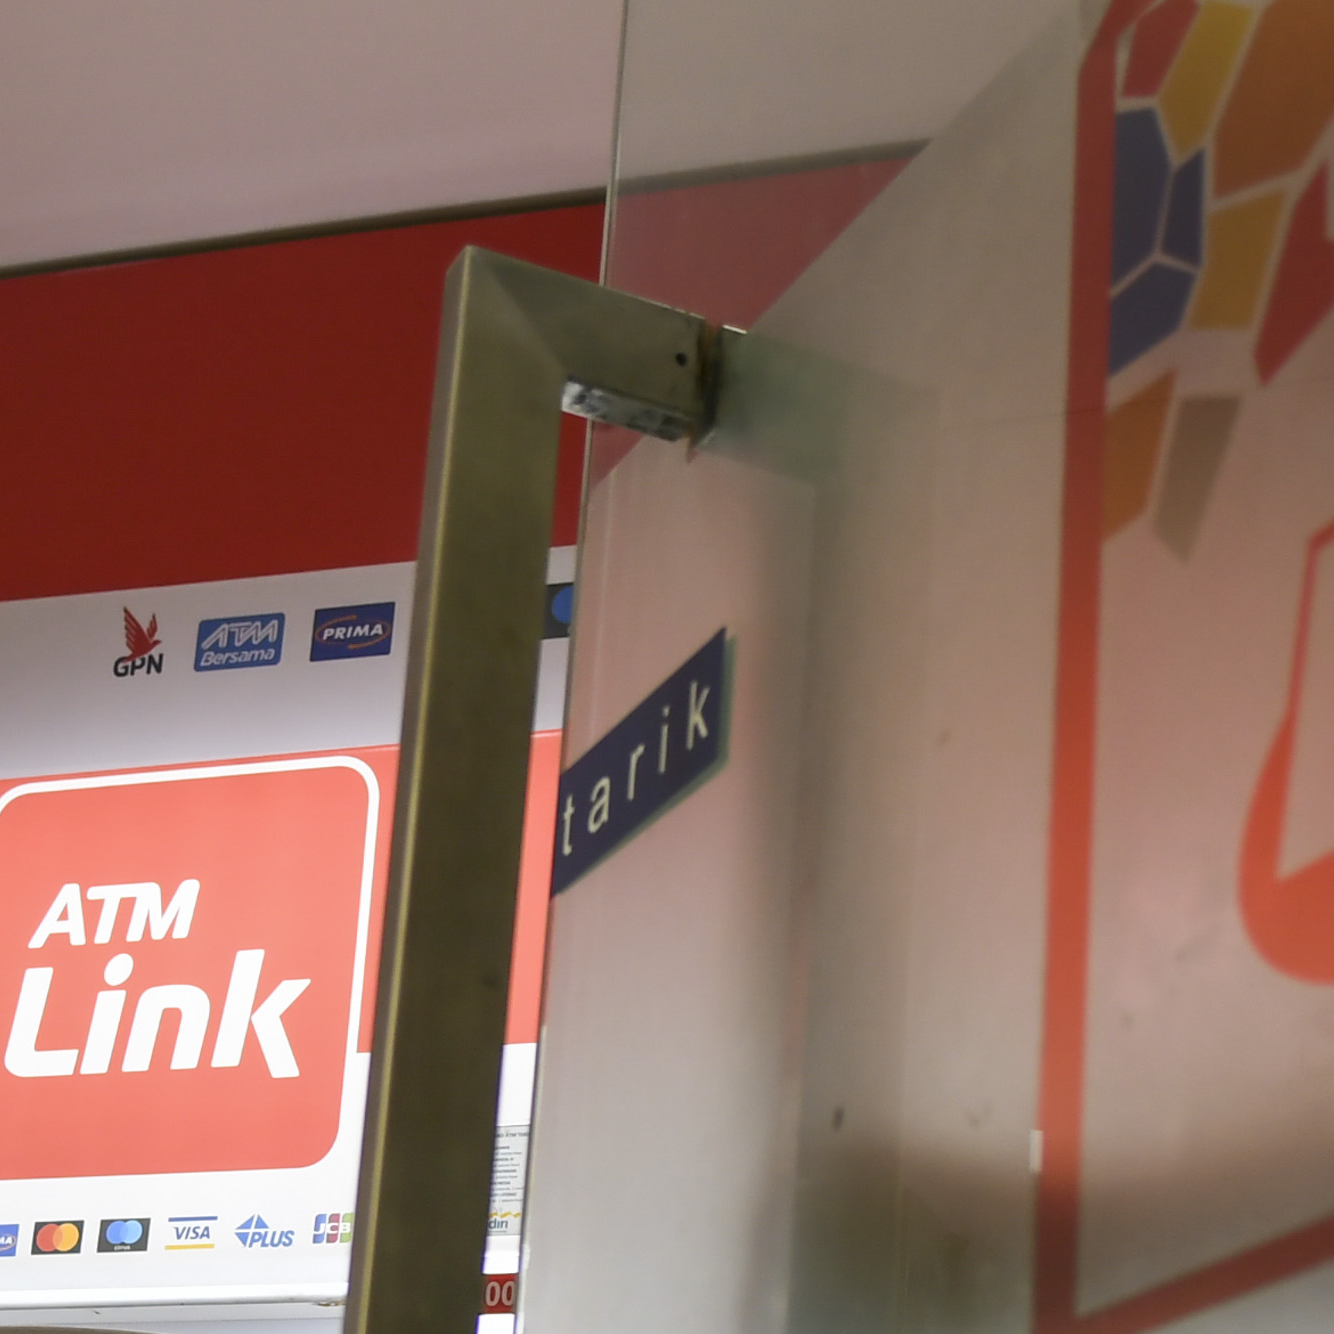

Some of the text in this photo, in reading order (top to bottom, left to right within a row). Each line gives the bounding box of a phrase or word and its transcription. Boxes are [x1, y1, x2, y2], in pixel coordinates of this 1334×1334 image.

[201, 619, 279, 651] ATM
[322, 623, 384, 641] PRIMA
[113, 653, 164, 678] GPN
[200, 648, 275, 668] Bersama
[561, 680, 711, 857] tarik
[27, 878, 201, 950] ATM
[3, 947, 312, 1080] Link
[173, 1226, 211, 1241] VISA
[248, 1230, 295, 1248] PLUS
